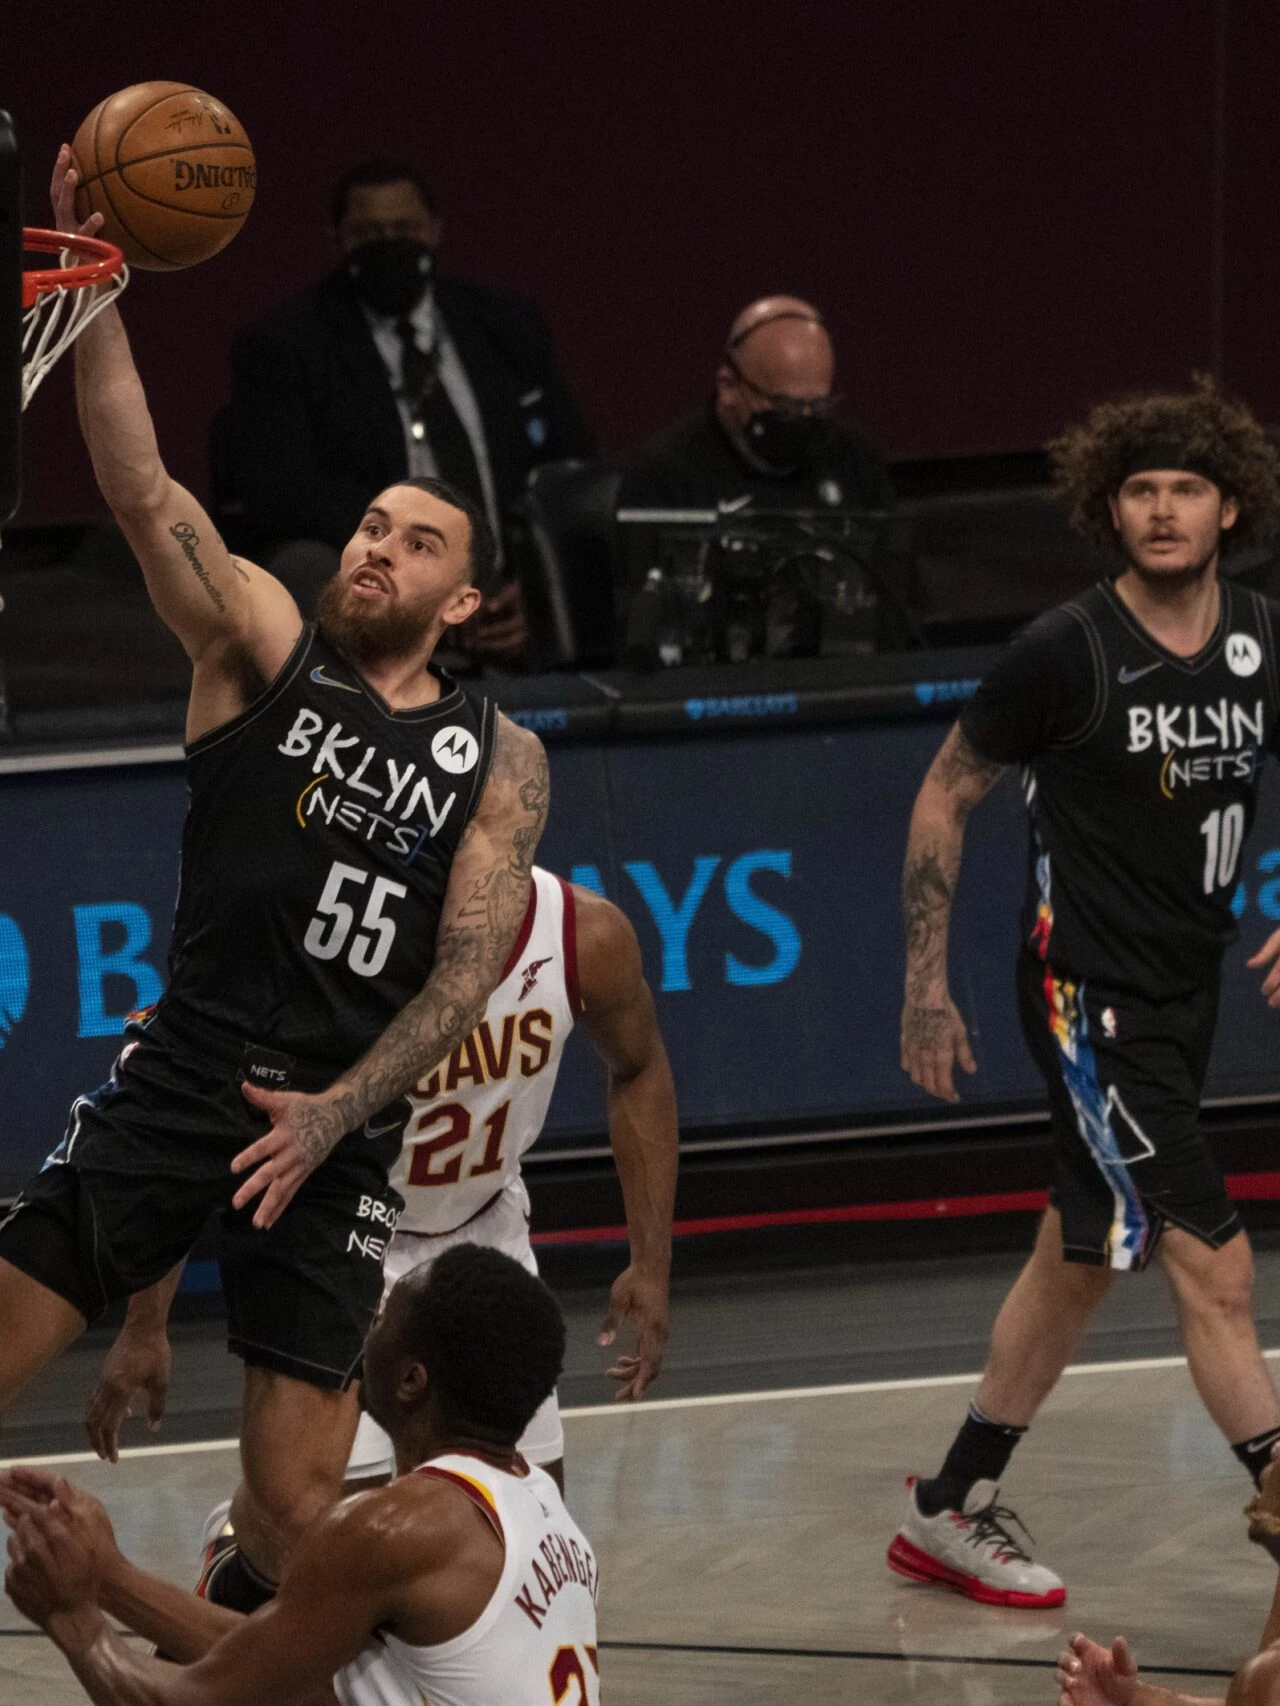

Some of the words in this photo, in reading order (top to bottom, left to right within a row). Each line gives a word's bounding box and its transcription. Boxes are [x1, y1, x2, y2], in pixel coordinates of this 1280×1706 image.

[1127, 698, 1264, 753] BKLYN
[1169, 751, 1252, 788] NETS
[278, 708, 456, 838] BKLYN
[306, 787, 420, 854] NETS
[1200, 803, 1245, 896] 10
[304, 861, 407, 978] 55
[250, 1063, 287, 1082] NETS
[408, 1099, 512, 1187] 21
[514, 1533, 599, 1630] KABENGE
